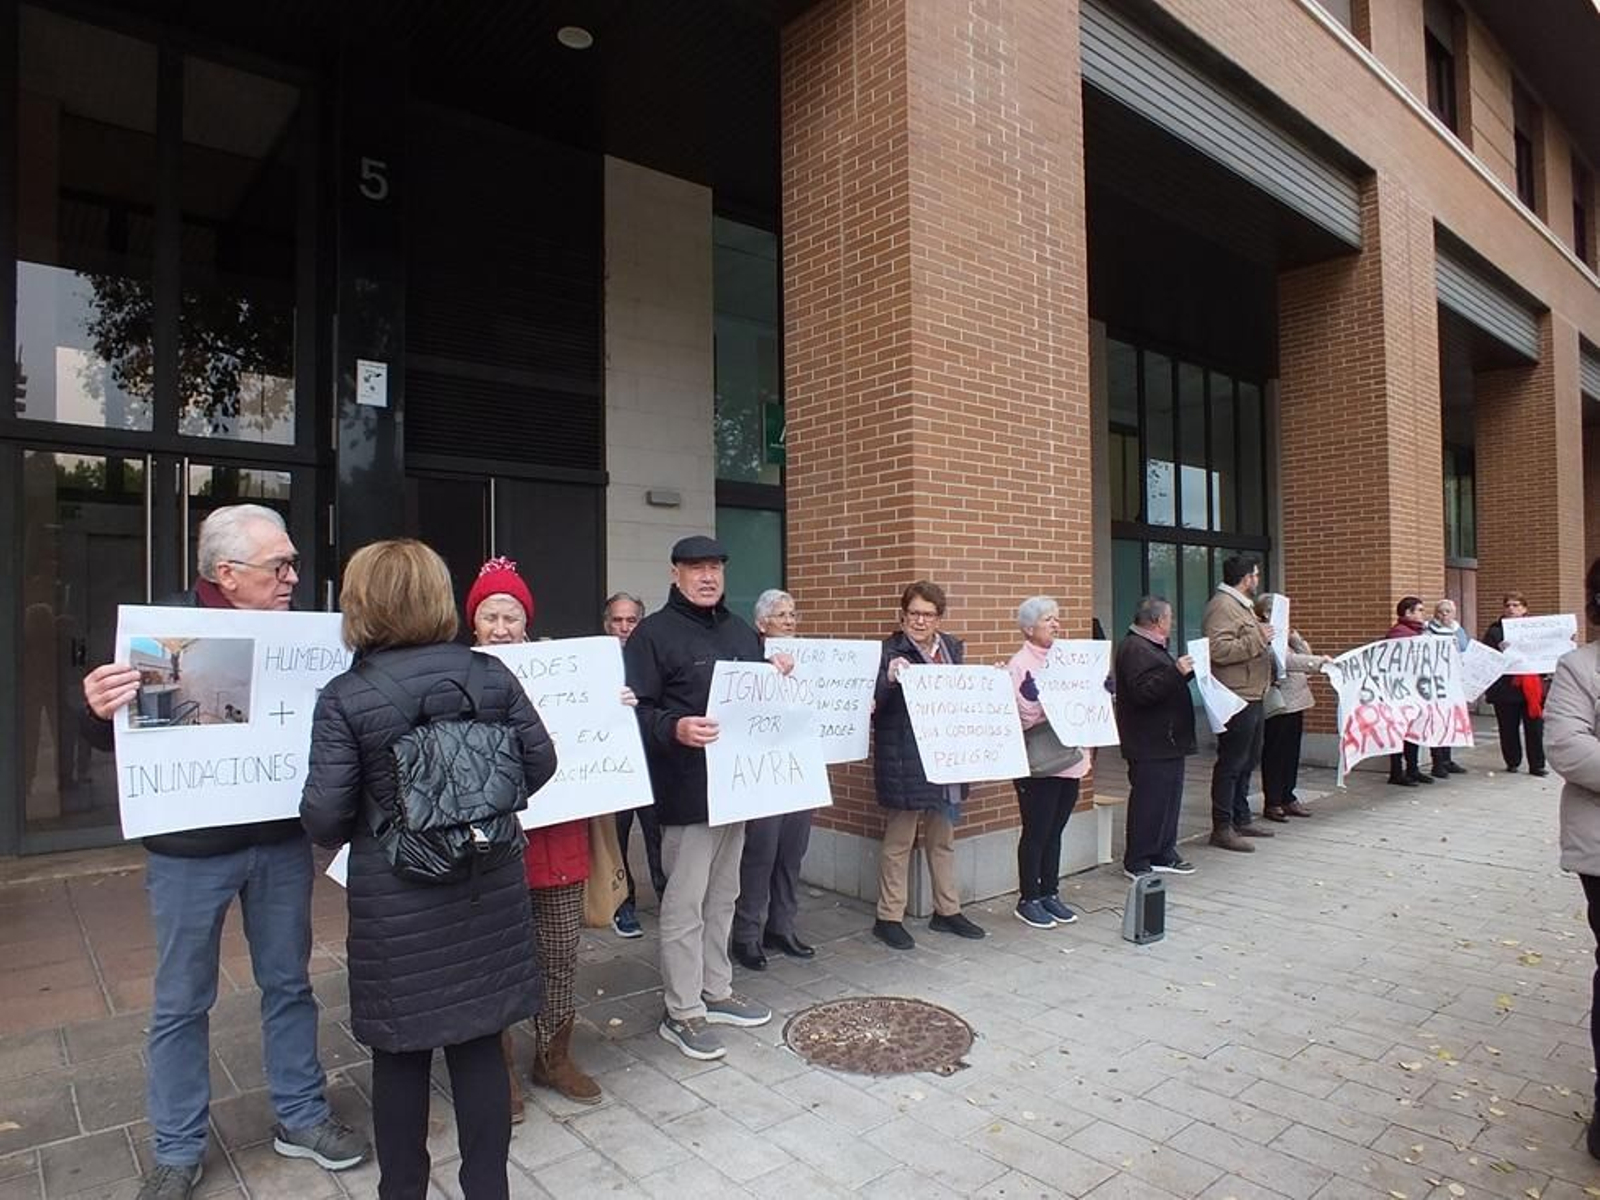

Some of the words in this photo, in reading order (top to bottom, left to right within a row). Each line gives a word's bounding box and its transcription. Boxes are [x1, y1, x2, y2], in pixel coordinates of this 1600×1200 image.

[359, 156, 389, 200] 5
[266, 646, 347, 671] HUMEDA
[577, 729, 610, 743] EN
[748, 715, 781, 736] POR
[126, 753, 298, 798] INUNDACIONES
[732, 751, 804, 791] AVRA
